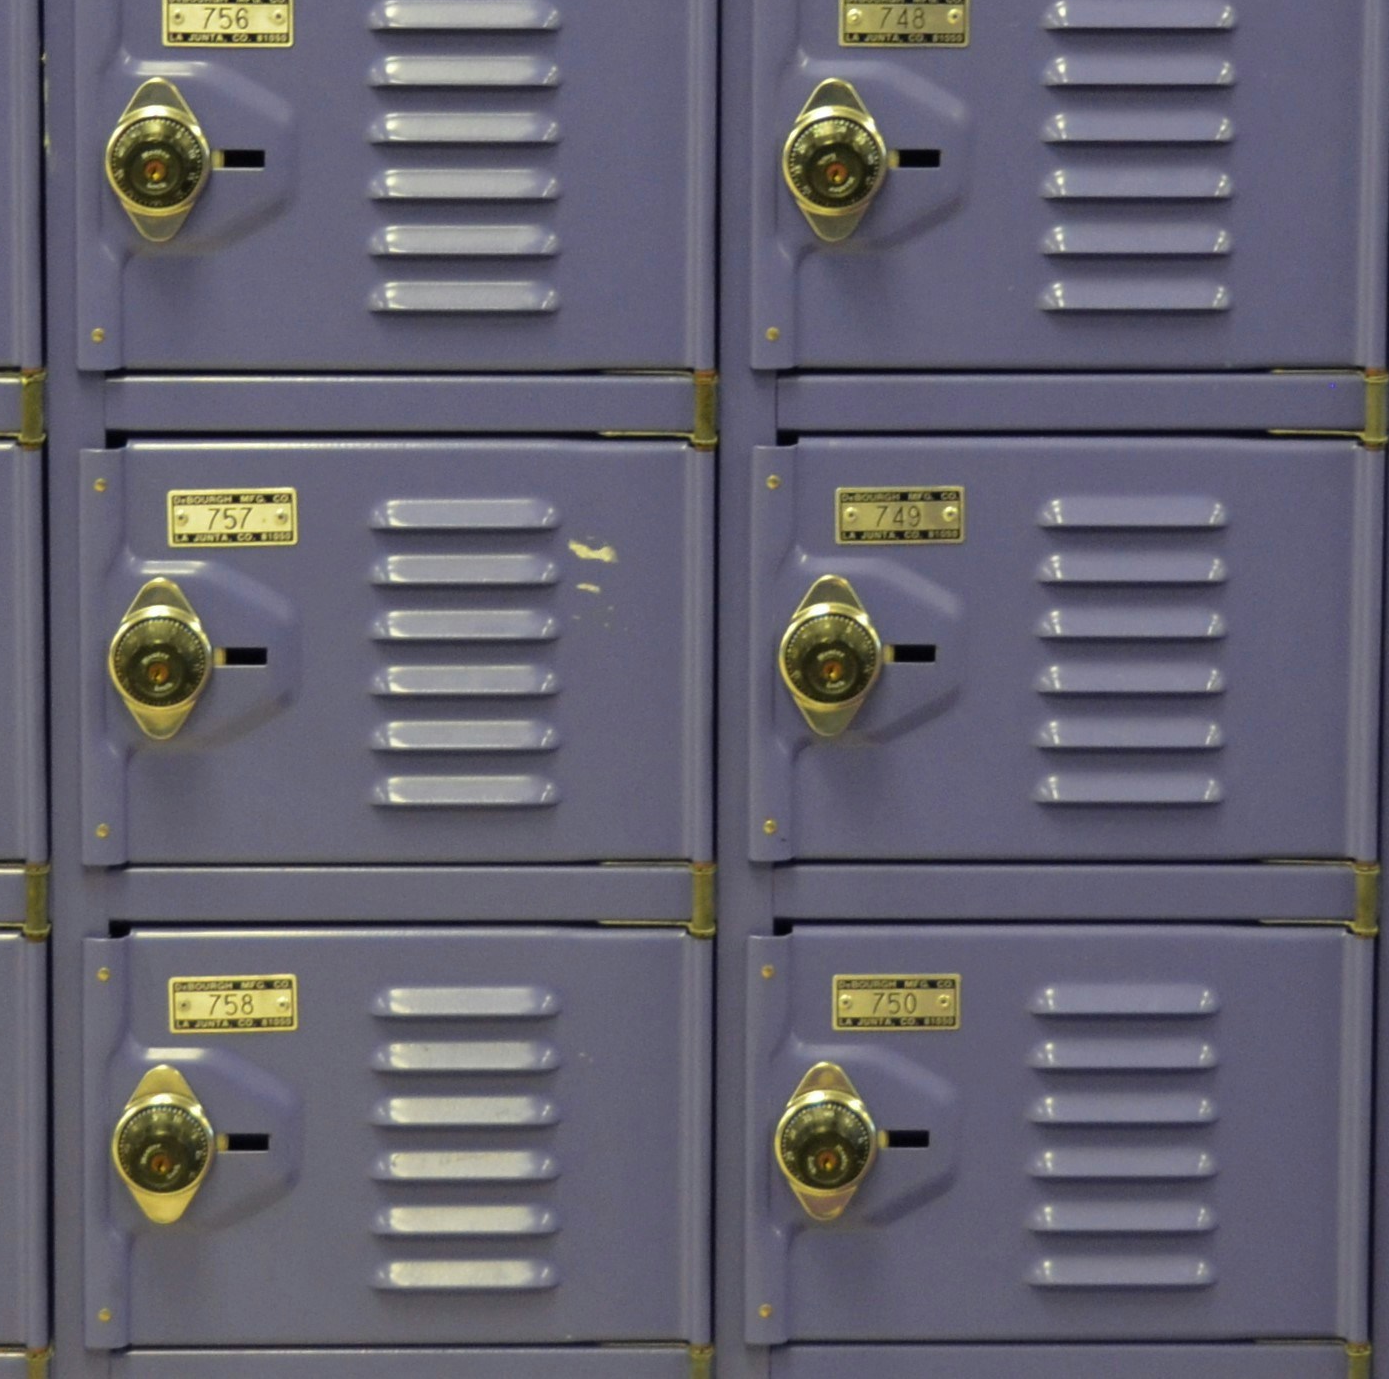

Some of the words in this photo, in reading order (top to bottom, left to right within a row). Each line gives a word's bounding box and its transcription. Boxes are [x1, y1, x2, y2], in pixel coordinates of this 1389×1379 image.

[203, 7, 249, 30] 756
[879, 7, 926, 30] 748
[207, 506, 254, 531] 757
[875, 504, 921, 528] 749
[208, 993, 254, 1017] 758
[872, 992, 917, 1015] 750
